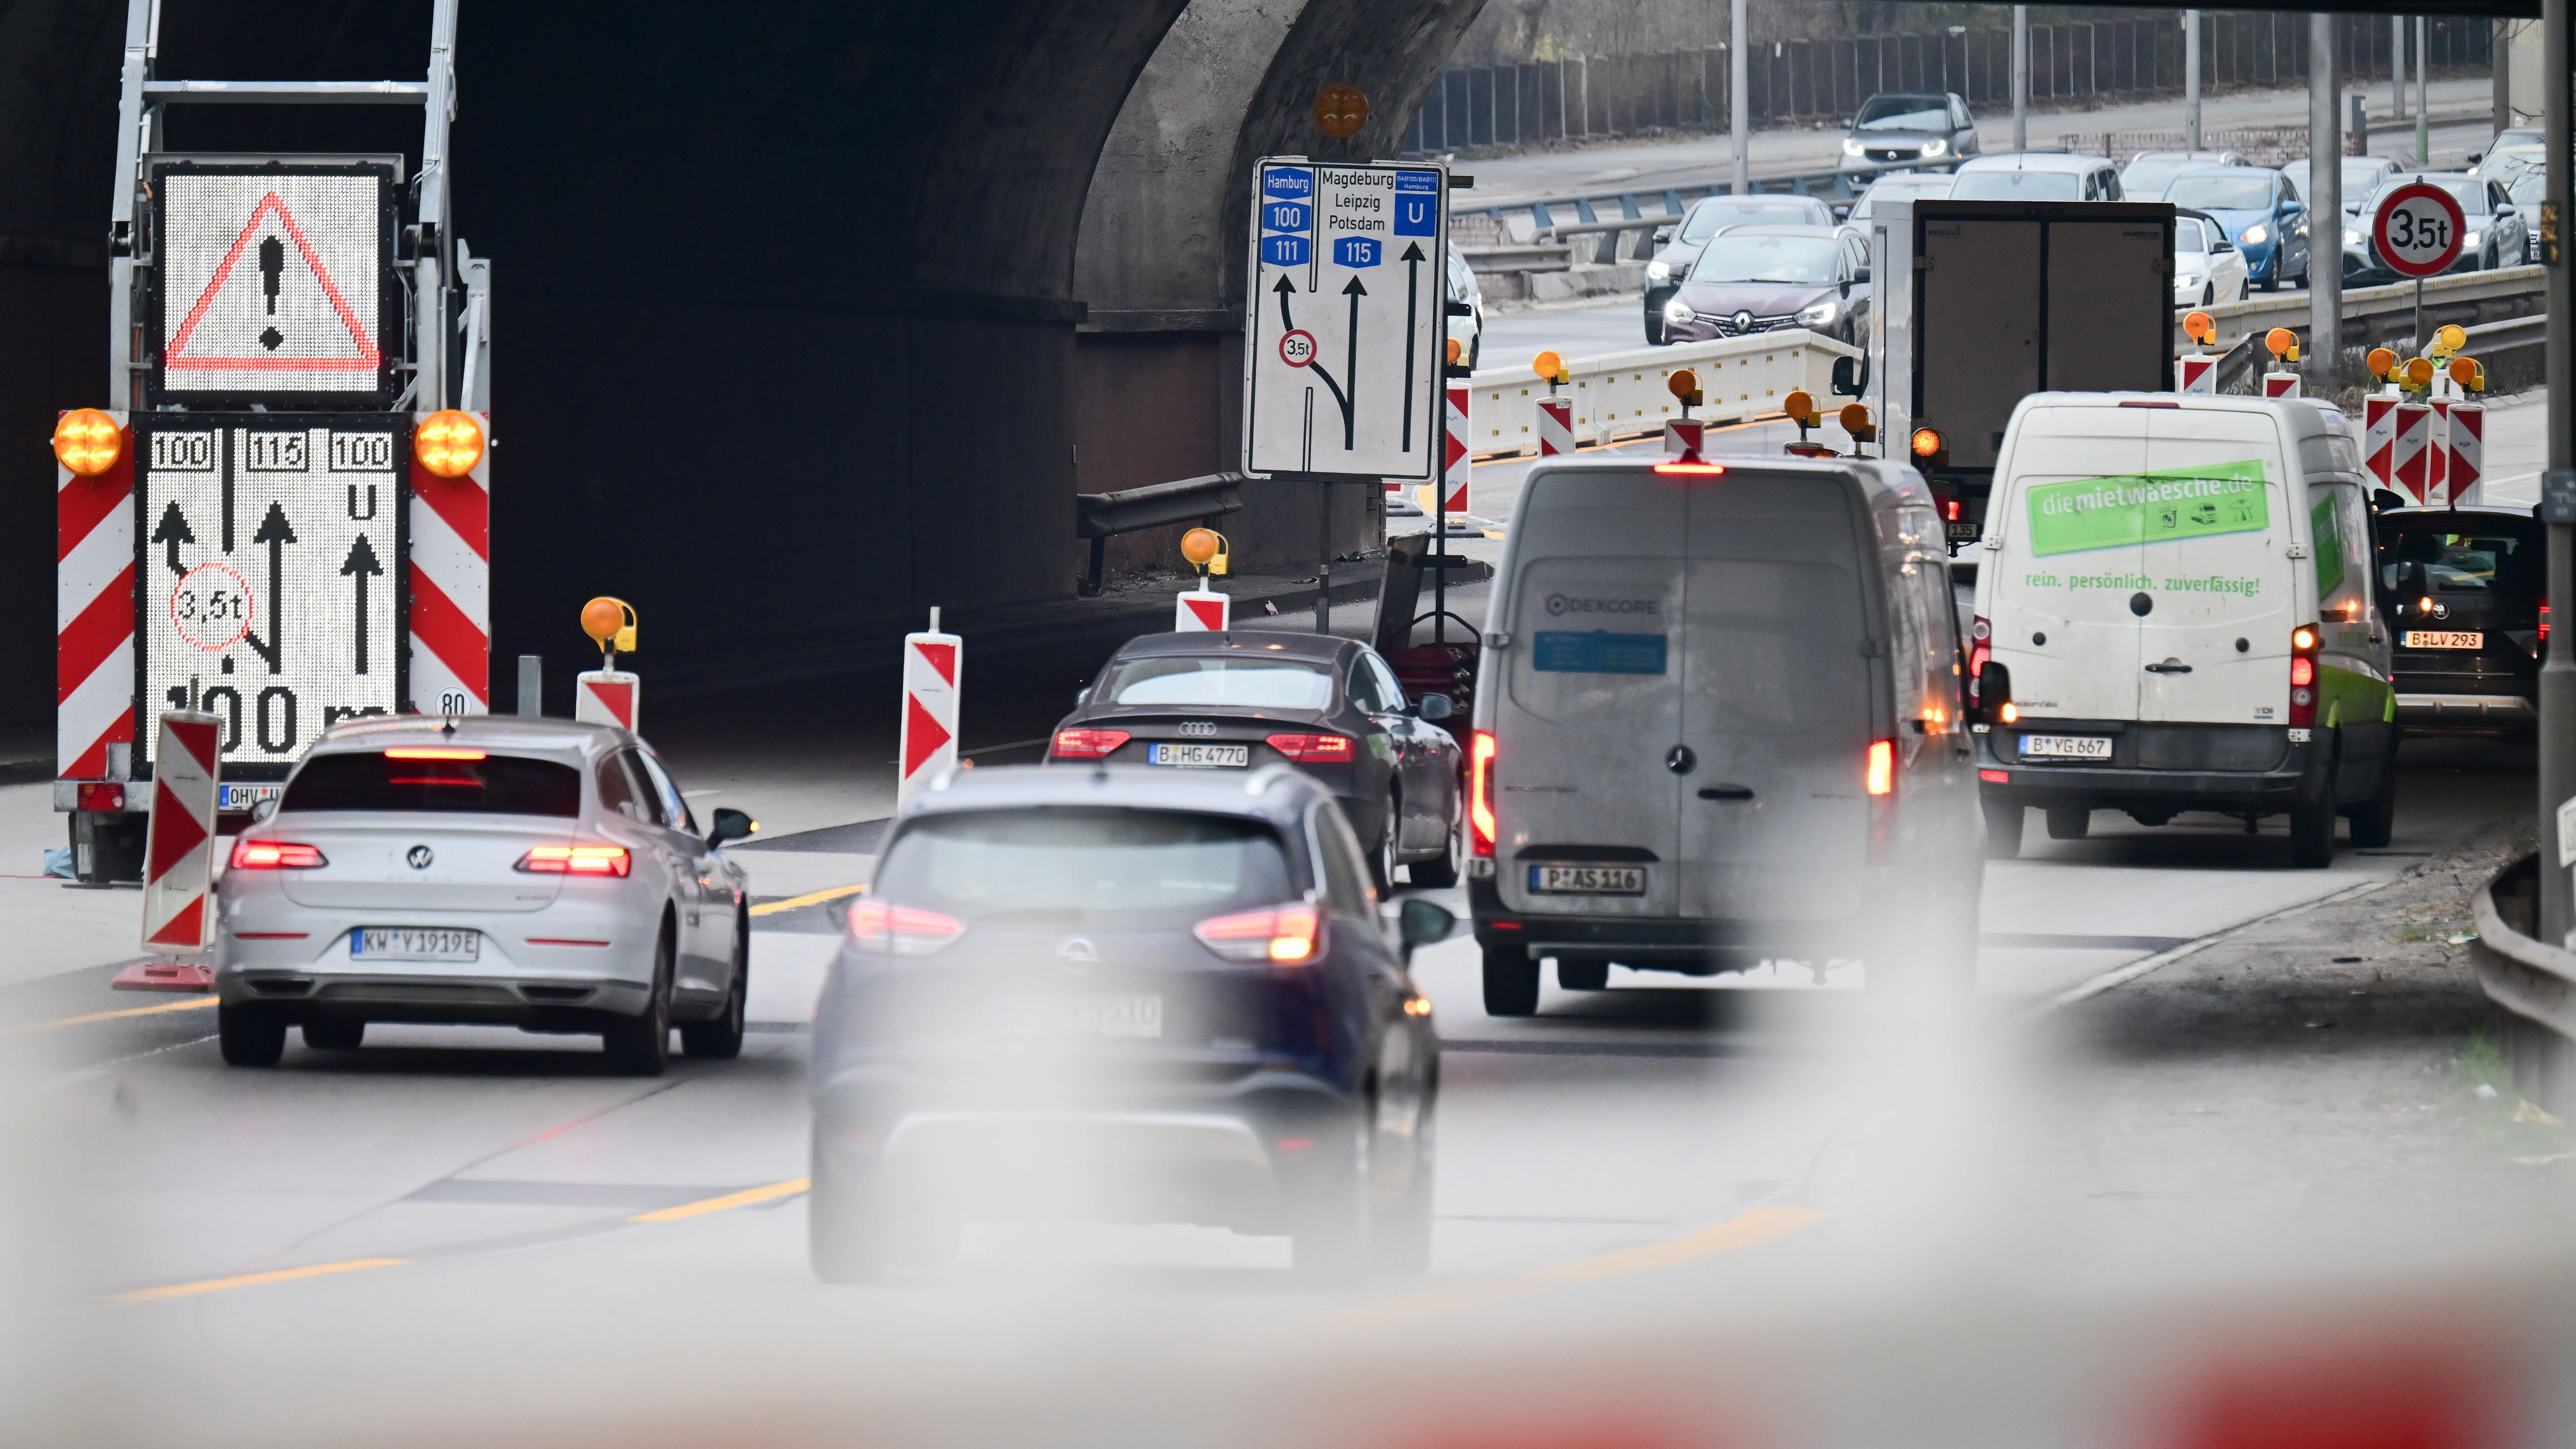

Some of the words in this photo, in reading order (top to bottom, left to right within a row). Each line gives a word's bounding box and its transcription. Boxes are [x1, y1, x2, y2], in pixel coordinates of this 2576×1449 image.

[1268, 175, 1309, 192] Hamburg
[1323, 171, 1394, 189] Magdeburg
[1336, 193, 1380, 212] Leipzig
[1274, 207, 1300, 228] 100
[1329, 215, 1385, 231] Potsdam
[1409, 203, 1424, 223] U
[2391, 209, 2448, 250] 3,5t
[1276, 240, 1297, 261] 111
[1346, 242, 1371, 263] 115
[1287, 339, 1309, 356] 3,5t
[156, 436, 207, 465] 100
[254, 437, 301, 465] 115
[336, 436, 389, 465] 100
[348, 484, 376, 520] U
[2043, 472, 2252, 516] diemietwaesche.de
[1952, 525, 1972, 536] 135
[2025, 571, 2061, 587] rein.
[2069, 573, 2157, 591] persönlich.
[2165, 576, 2260, 597] zuverlässig!
[179, 591, 243, 623] 3,5t
[1571, 599, 1659, 615] DEXCORE
[2413, 633, 2420, 645] B
[2431, 633, 2448, 646] LV
[2452, 634, 2477, 647] 293
[442, 693, 464, 715] 80
[167, 686, 297, 754] 00
[1160, 747, 1169, 761] B
[1182, 747, 1202, 762] HG
[1206, 748, 1245, 763] 4770
[2034, 738, 2042, 751] B
[2055, 739, 2072, 753] YG
[2078, 741, 2105, 754] 667
[230, 789, 258, 804] OHV
[1549, 869, 1560, 888] P
[365, 932, 386, 952] KW
